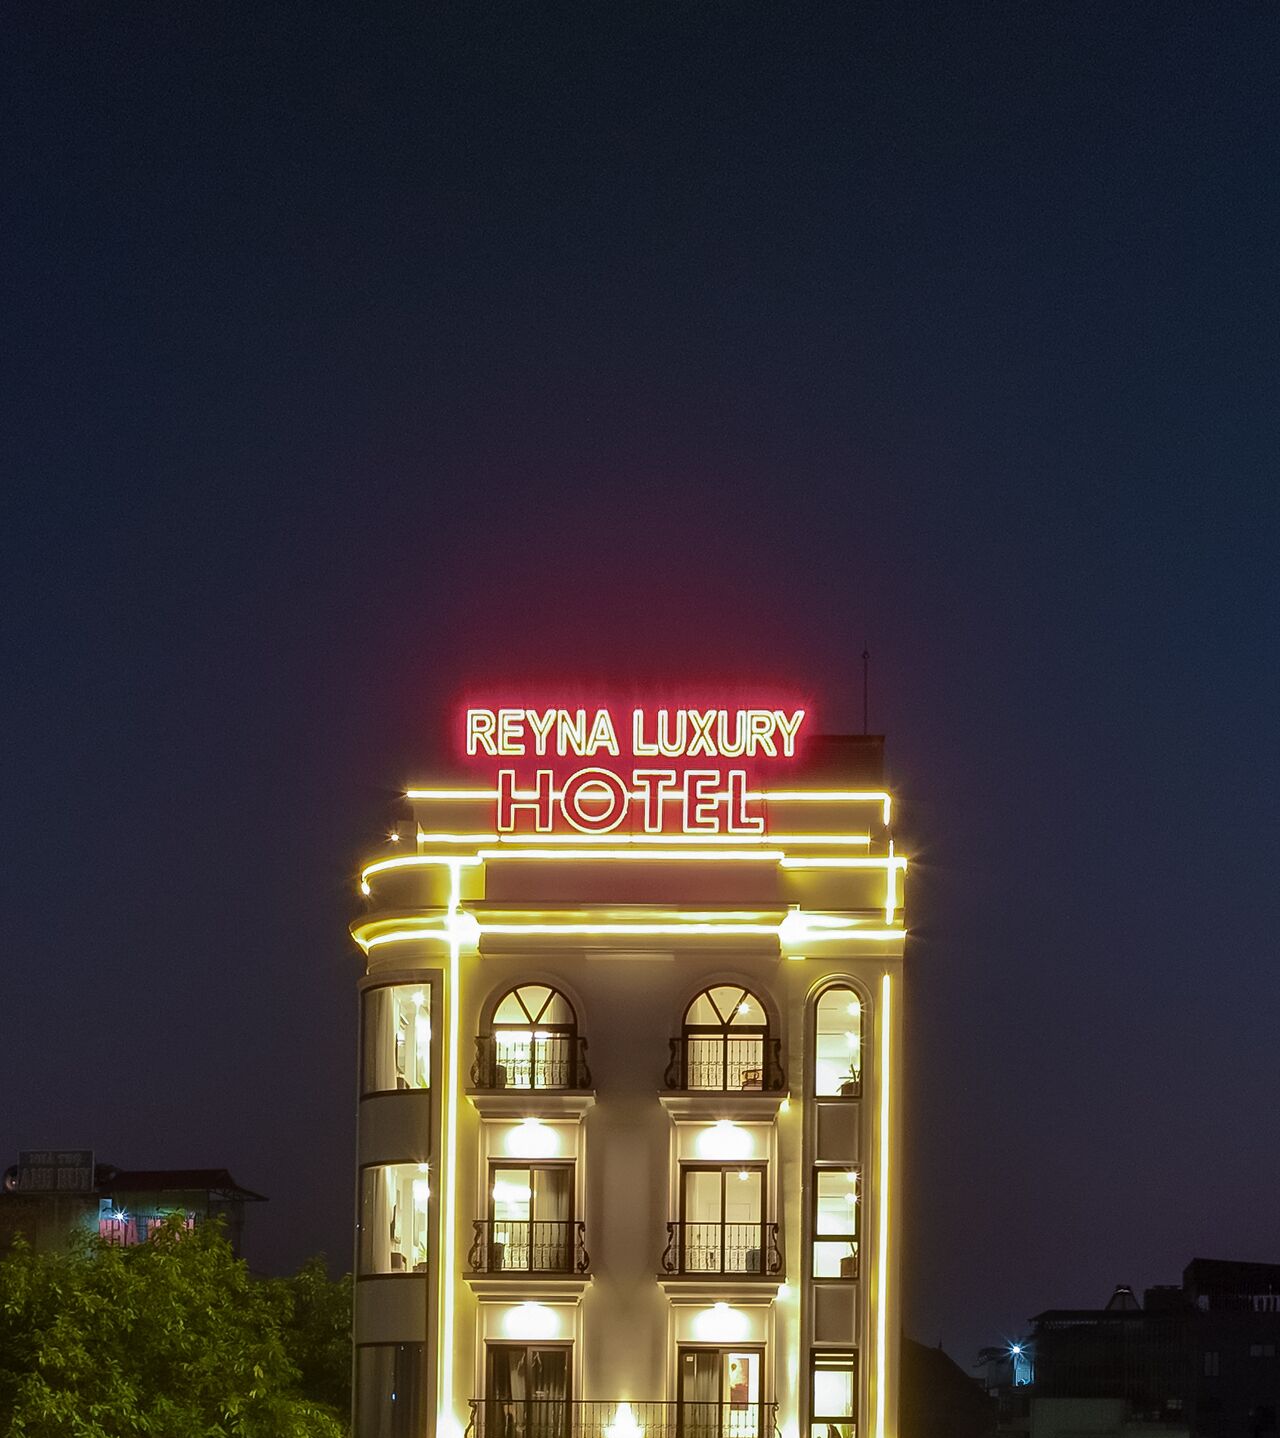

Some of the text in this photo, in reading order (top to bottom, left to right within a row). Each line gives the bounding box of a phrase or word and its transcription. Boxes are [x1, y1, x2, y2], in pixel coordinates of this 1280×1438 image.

[466, 709, 806, 757] REYNA LUXURY
[498, 767, 765, 833] HOTEL
